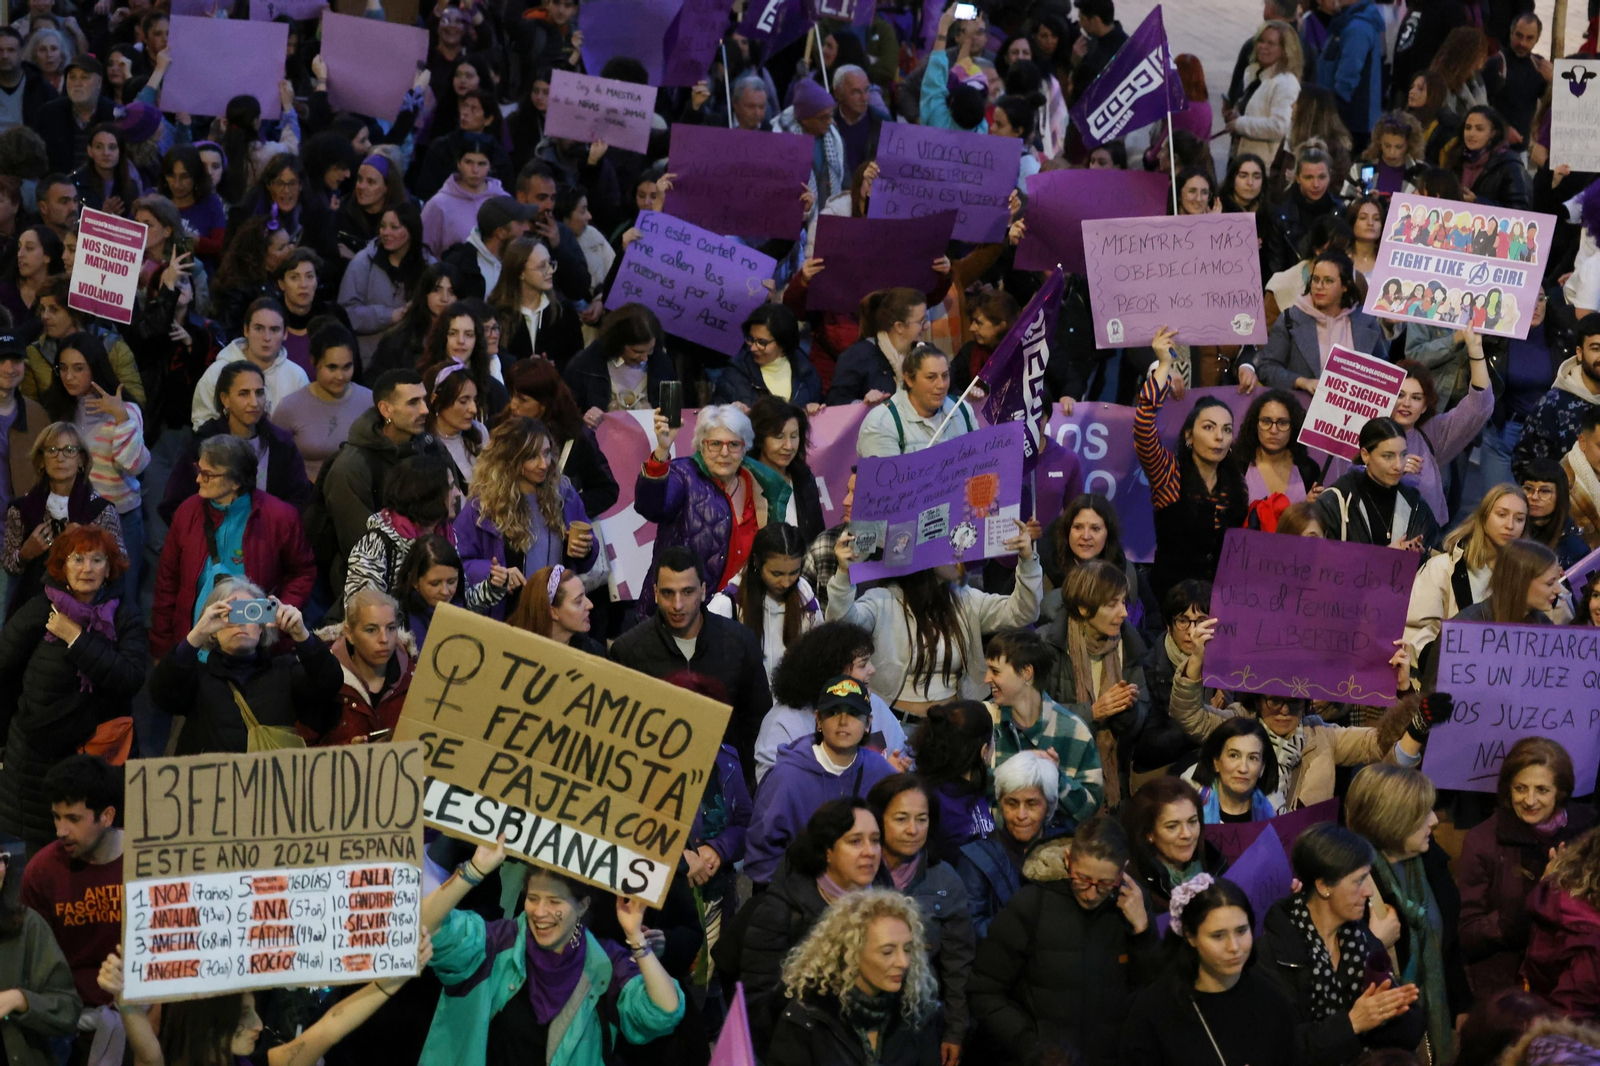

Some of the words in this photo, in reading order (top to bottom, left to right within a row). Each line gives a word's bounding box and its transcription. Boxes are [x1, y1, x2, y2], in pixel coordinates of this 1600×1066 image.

[578, 99, 600, 112] NIÑAS
[606, 87, 642, 102] MAESTRA
[887, 129, 904, 155] LA
[918, 140, 994, 168] VIOLENCIA
[939, 187, 956, 202] ES
[81, 237, 102, 254] NOS
[102, 244, 137, 264] SIGUEN
[639, 213, 659, 234] En
[665, 226, 691, 246] este
[740, 257, 758, 271] no
[1101, 230, 1195, 256] MIENTRAS
[1210, 225, 1244, 251] MÁS
[84, 254, 129, 277] MATANDO
[633, 240, 654, 258] me
[660, 250, 695, 275] caben
[705, 263, 724, 286] las
[1113, 257, 1244, 282] OBEDECÍAMOS
[1390, 251, 1433, 271] FIGHT
[1434, 257, 1466, 277] LIKE
[1492, 268, 1525, 287] GIRL
[100, 273, 107, 286] Y
[627, 259, 675, 290] razones
[684, 286, 709, 300] por
[716, 288, 738, 314] las
[78, 281, 124, 306] VIOLANDO
[622, 281, 643, 298] que
[657, 294, 686, 320] estoy
[1113, 293, 1160, 313] PEOR
[1169, 292, 1194, 309] NOS
[1201, 289, 1262, 309] TRATABAN
[1324, 375, 1349, 394] NOS
[1348, 383, 1391, 409] SIGUEN
[1325, 391, 1379, 420] MATANDO
[1313, 418, 1360, 446] VIOLAND
[1343, 414, 1352, 426] Y
[875, 460, 936, 490] Quiero
[922, 483, 960, 503] mundo
[1225, 536, 1251, 570] Mi
[1258, 555, 1312, 581] madre
[1318, 566, 1345, 586] me
[1353, 563, 1381, 589] dio
[1388, 560, 1405, 595] la
[1269, 582, 1288, 612] el
[1255, 620, 1370, 652] LIBERTAD
[1445, 629, 1470, 654] EL
[1480, 628, 1600, 661] PATRIARCA
[500, 650, 560, 707] TU
[1451, 663, 1477, 684] ES
[1487, 665, 1513, 686] UN
[1520, 666, 1570, 689] JUEZ
[1490, 703, 1575, 731] JUZGA
[418, 732, 464, 770] SE
[614, 812, 681, 857] CON
[135, 846, 205, 878] ESTE
[217, 842, 261, 869] AÑO
[274, 841, 329, 868] 2024
[339, 833, 417, 861] ESPAÑA
[349, 868, 390, 889] LAILA
[55, 897, 120, 917] FASCIST
[154, 882, 188, 907] NOA
[63, 908, 121, 927] ACTION
[153, 906, 199, 929] NATALIA
[253, 899, 288, 920] ANA
[347, 912, 386, 933] SILVIA
[152, 932, 195, 953] AMELIA
[249, 921, 295, 949] FÁTIMA
[146, 956, 199, 981] ÁNGELES
[250, 949, 292, 974] ROCÍO
